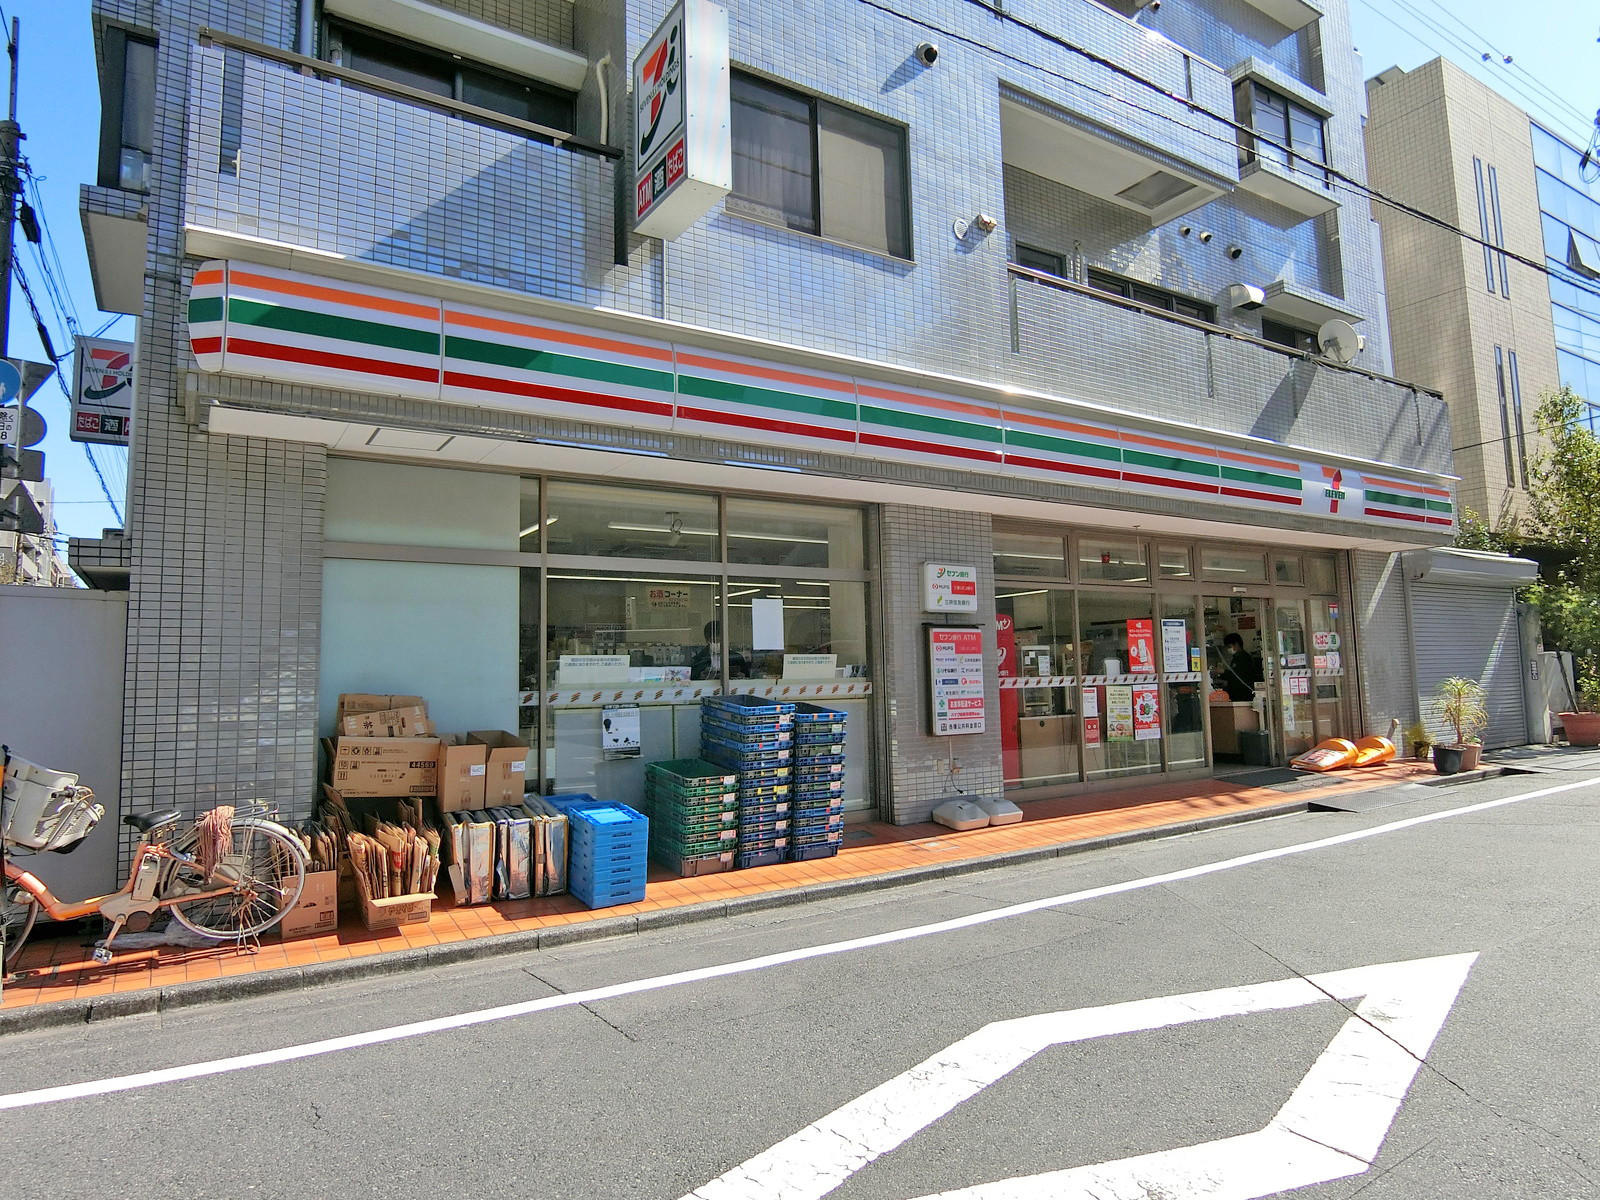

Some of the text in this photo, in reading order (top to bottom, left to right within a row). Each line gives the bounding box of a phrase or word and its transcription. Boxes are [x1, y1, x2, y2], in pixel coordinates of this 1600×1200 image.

[638, 148, 684, 211] ATM 酒 たばこ
[78, 415, 99, 430] たばこ
[104, 418, 119, 432] 酒
[649, 590, 689, 598] お酒コーナー
[1314, 634, 1329, 645] たばこ
